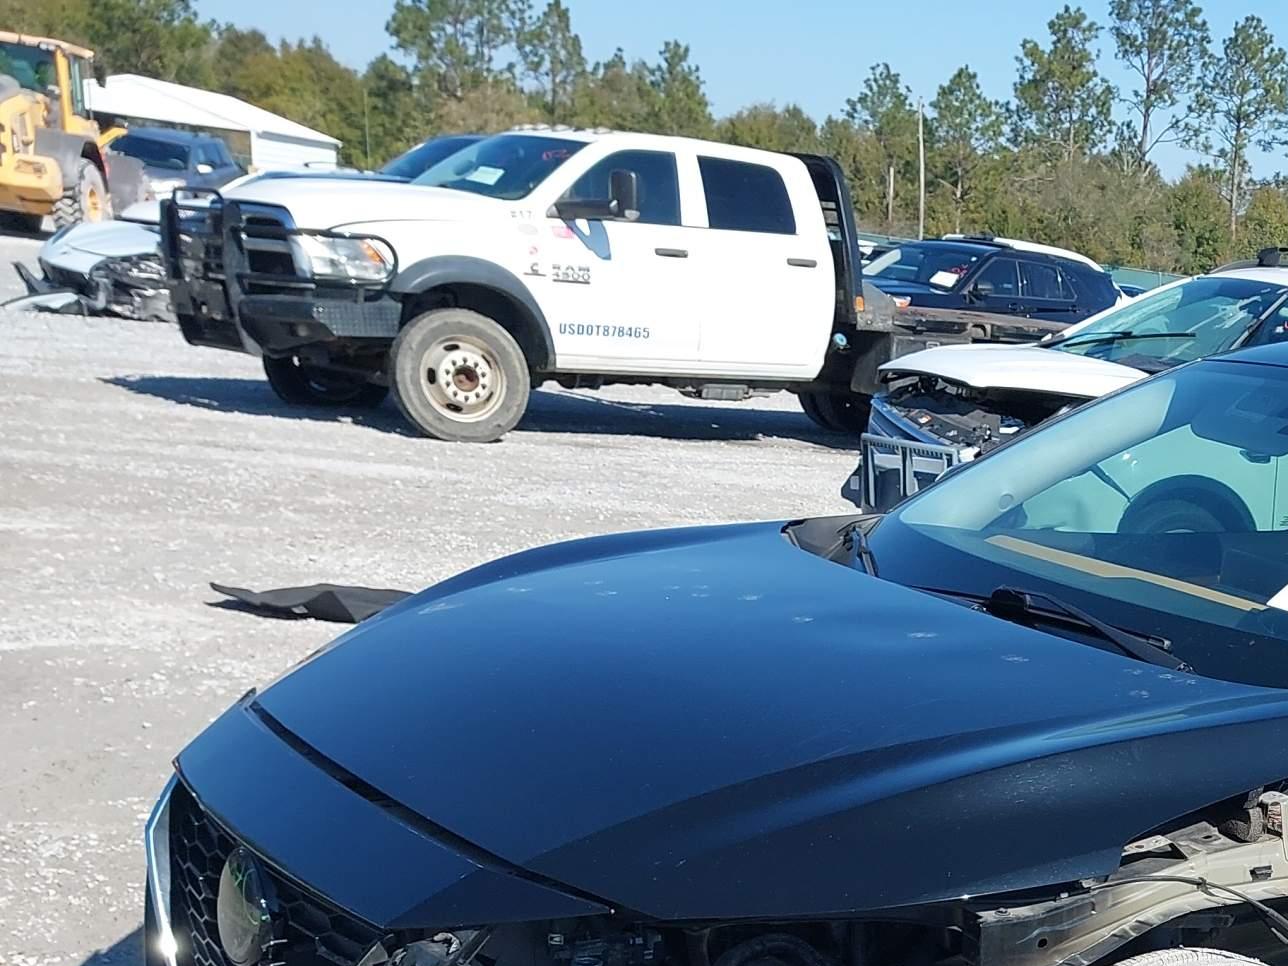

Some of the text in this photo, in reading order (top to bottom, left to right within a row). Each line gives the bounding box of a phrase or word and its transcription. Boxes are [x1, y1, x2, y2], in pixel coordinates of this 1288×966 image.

[552, 264, 591, 273] RAM
[552, 271, 591, 281] 4500
[559, 322, 651, 339] USDOT878465
